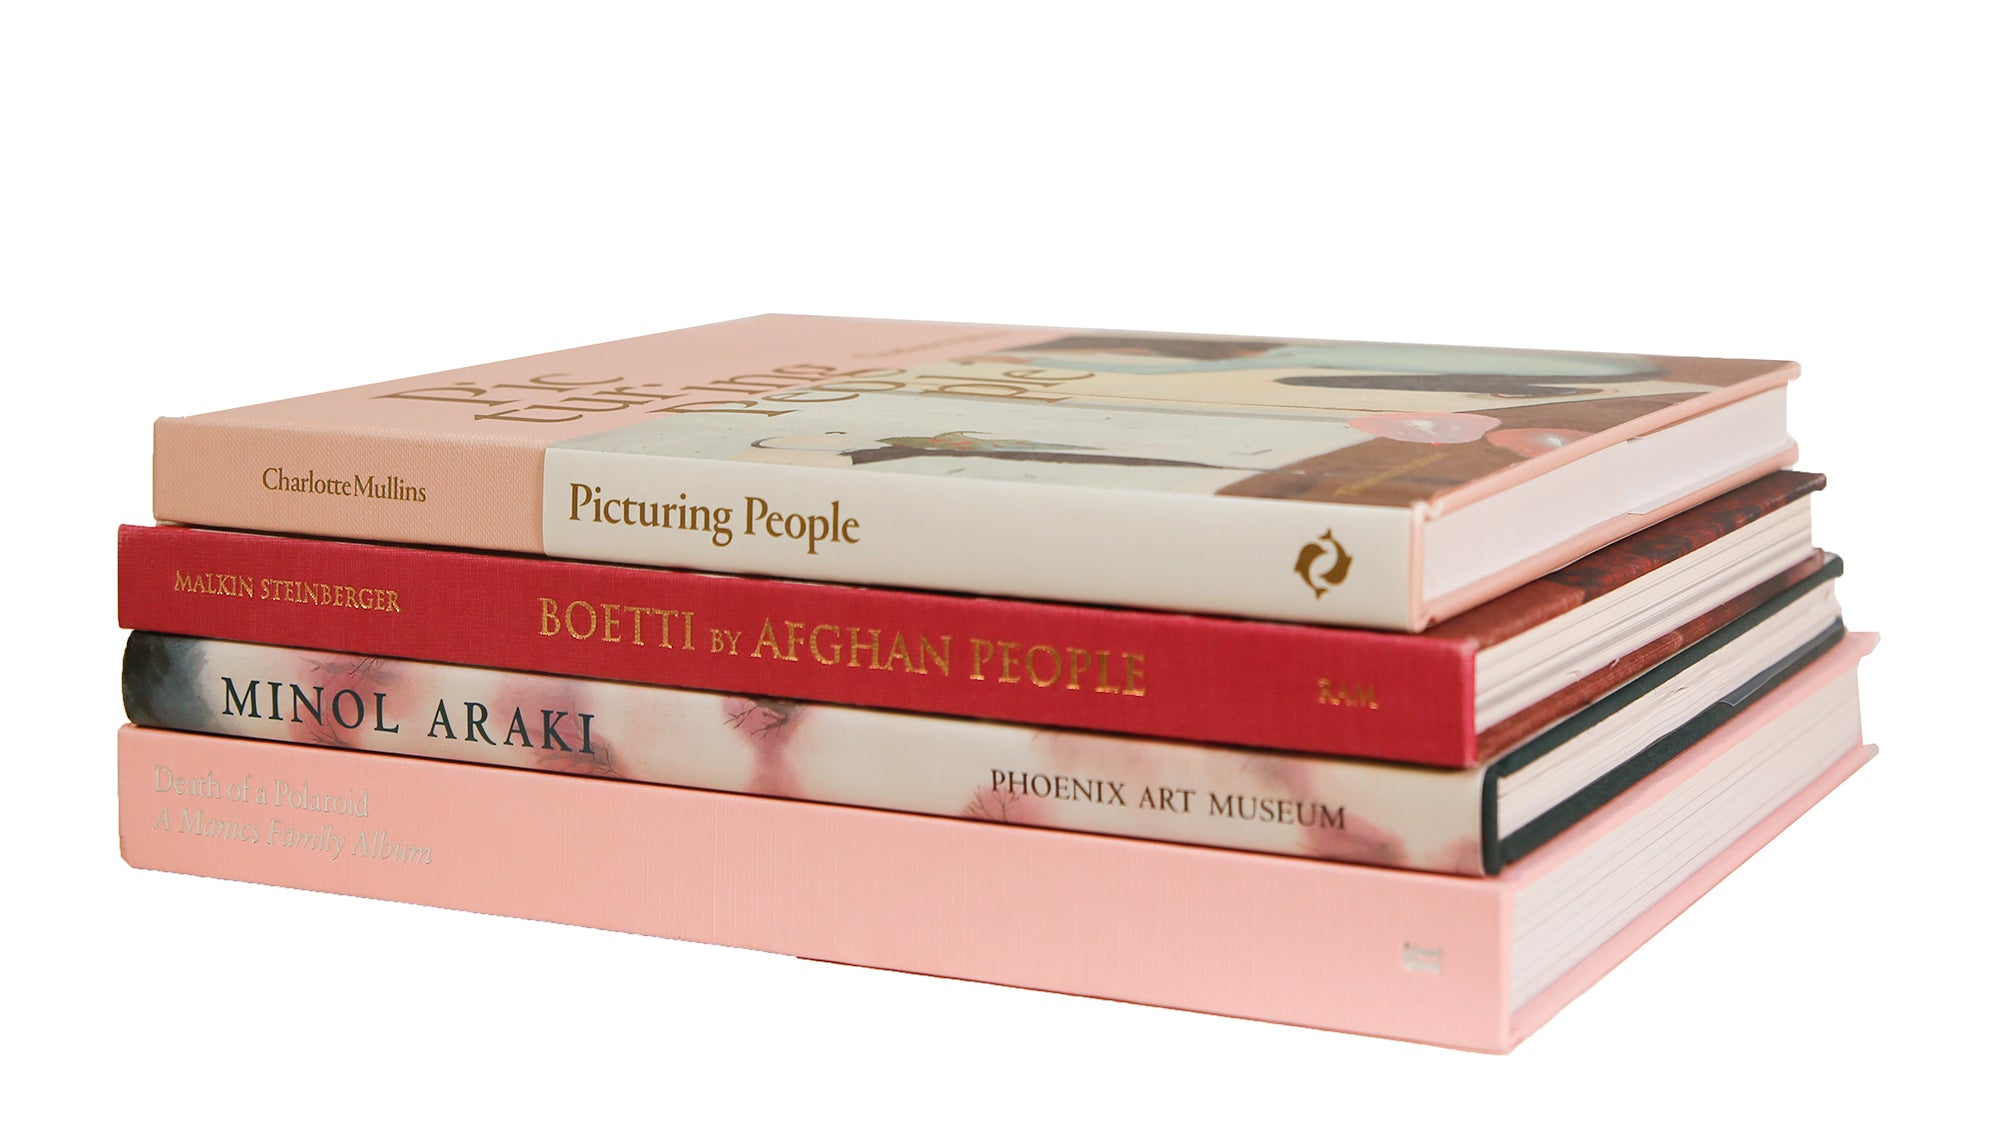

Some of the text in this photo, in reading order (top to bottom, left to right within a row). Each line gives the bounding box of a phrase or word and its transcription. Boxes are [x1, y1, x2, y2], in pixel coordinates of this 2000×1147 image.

[354, 474, 427, 502] Mullins
[568, 482, 860, 555] Picturing People
[174, 570, 401, 613] MALKIN STEINBERGER
[537, 597, 1146, 697] BOETTI BY AFGHAN PEOPLE
[220, 676, 595, 755] MINOL ARAKI
[153, 765, 369, 817] Death of a Polaroid
[990, 769, 1347, 831] PHOENIX ART MUSEUM
[153, 805, 433, 865] A Manics Family Album
